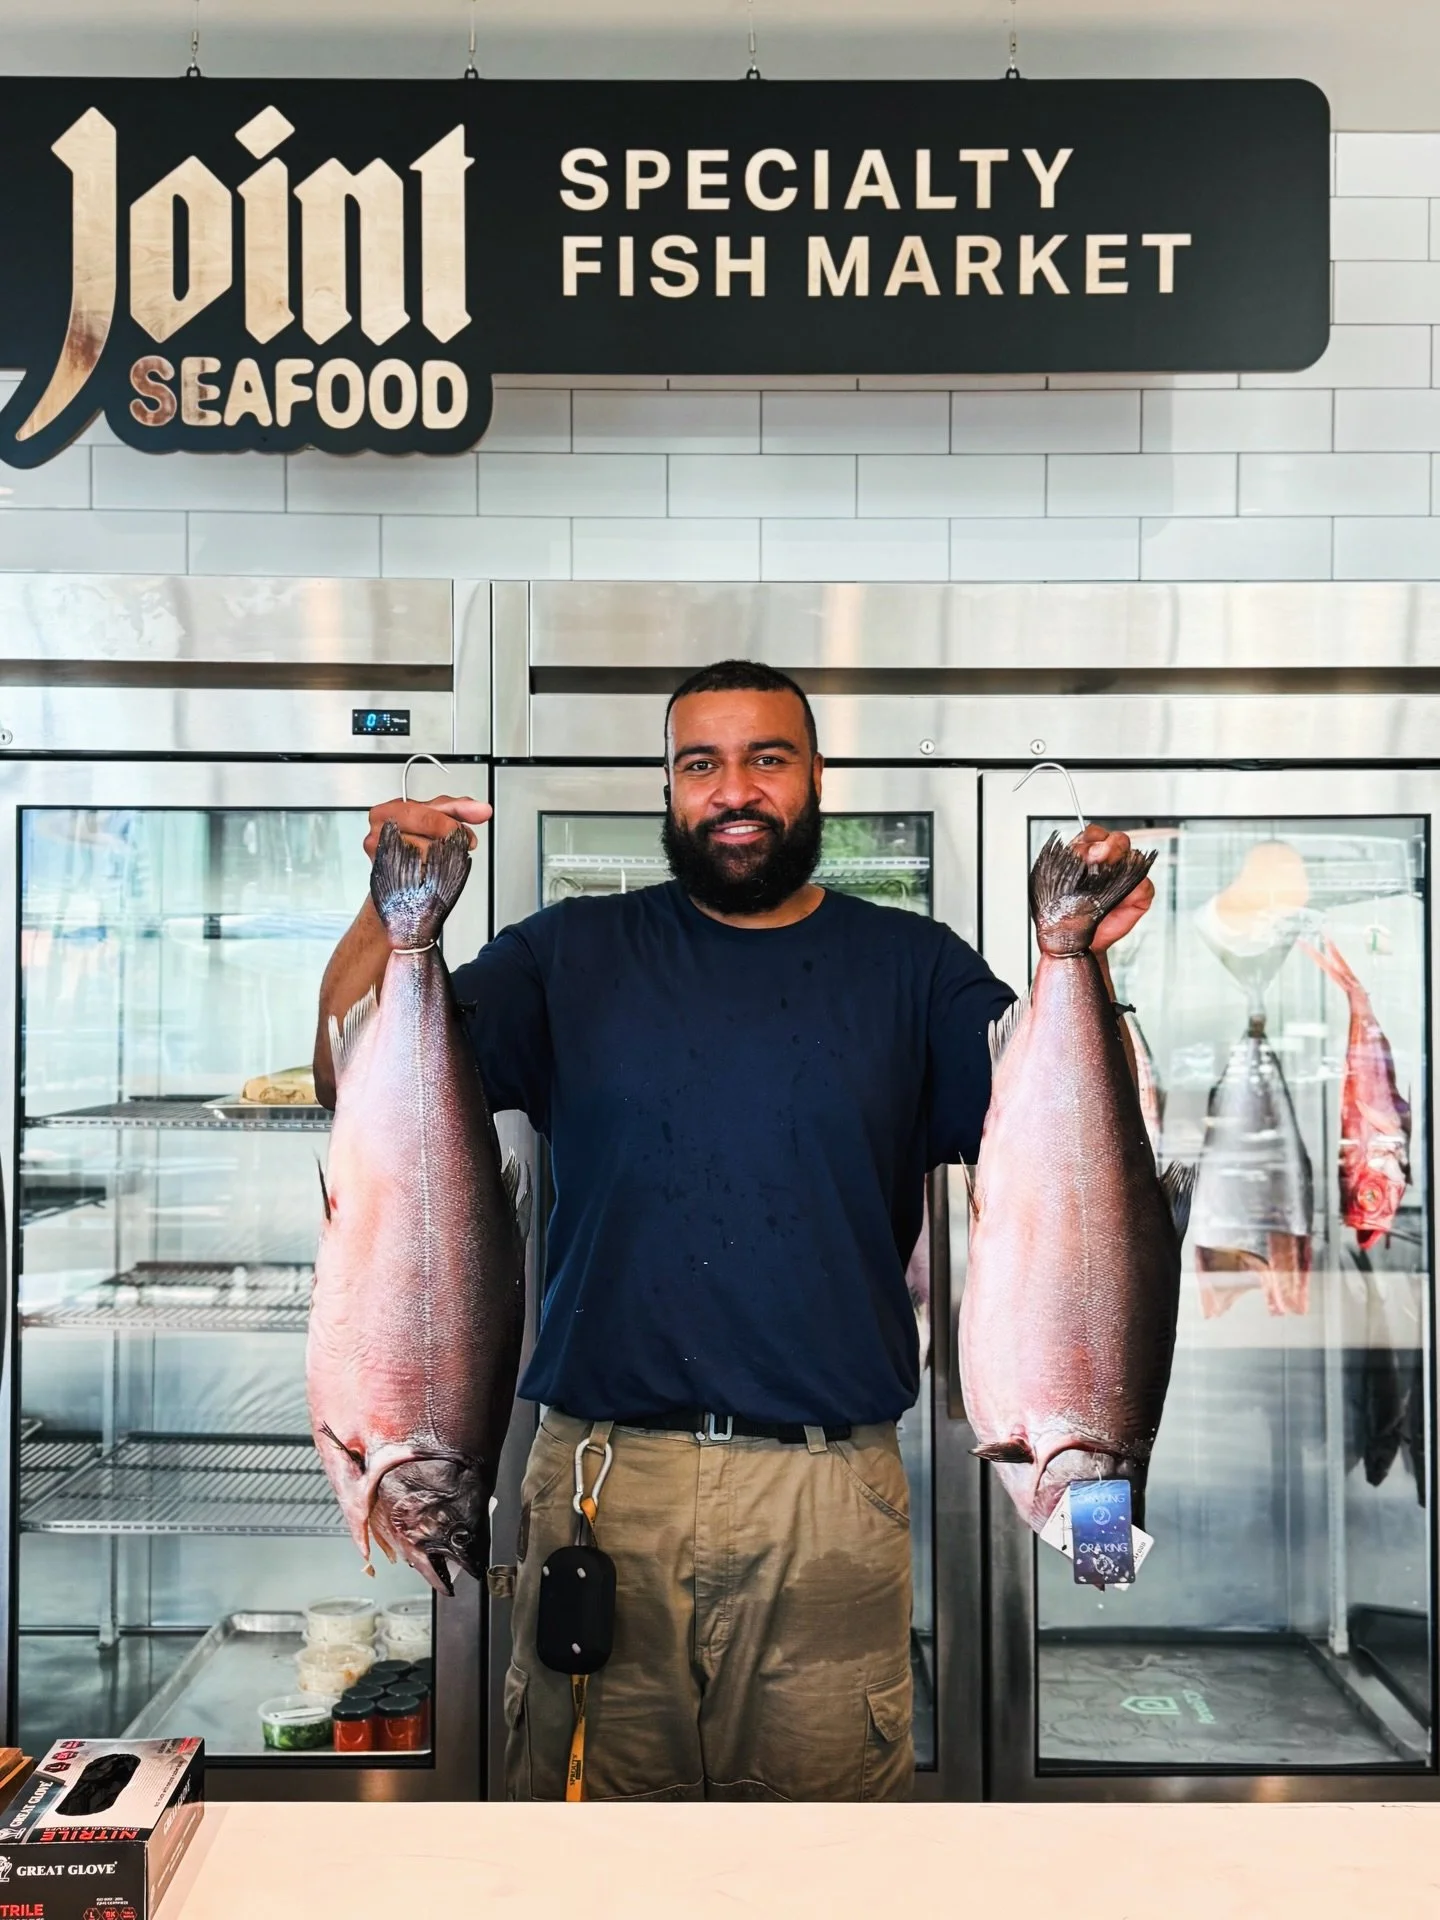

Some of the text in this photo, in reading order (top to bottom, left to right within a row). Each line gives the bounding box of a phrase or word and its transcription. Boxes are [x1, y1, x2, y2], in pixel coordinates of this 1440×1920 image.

[560, 148, 1073, 211] SPECIALTY
[16, 105, 476, 441] Joint
[563, 234, 1191, 297] FISH MARKET
[130, 355, 468, 429] SEAFOOD
[1079, 1542, 1101, 1554] ORA
[1104, 1542, 1128, 1552] KING
[40, 1830, 138, 1841] NITRILE
[16, 1864, 116, 1877] GREAT GLOVE
